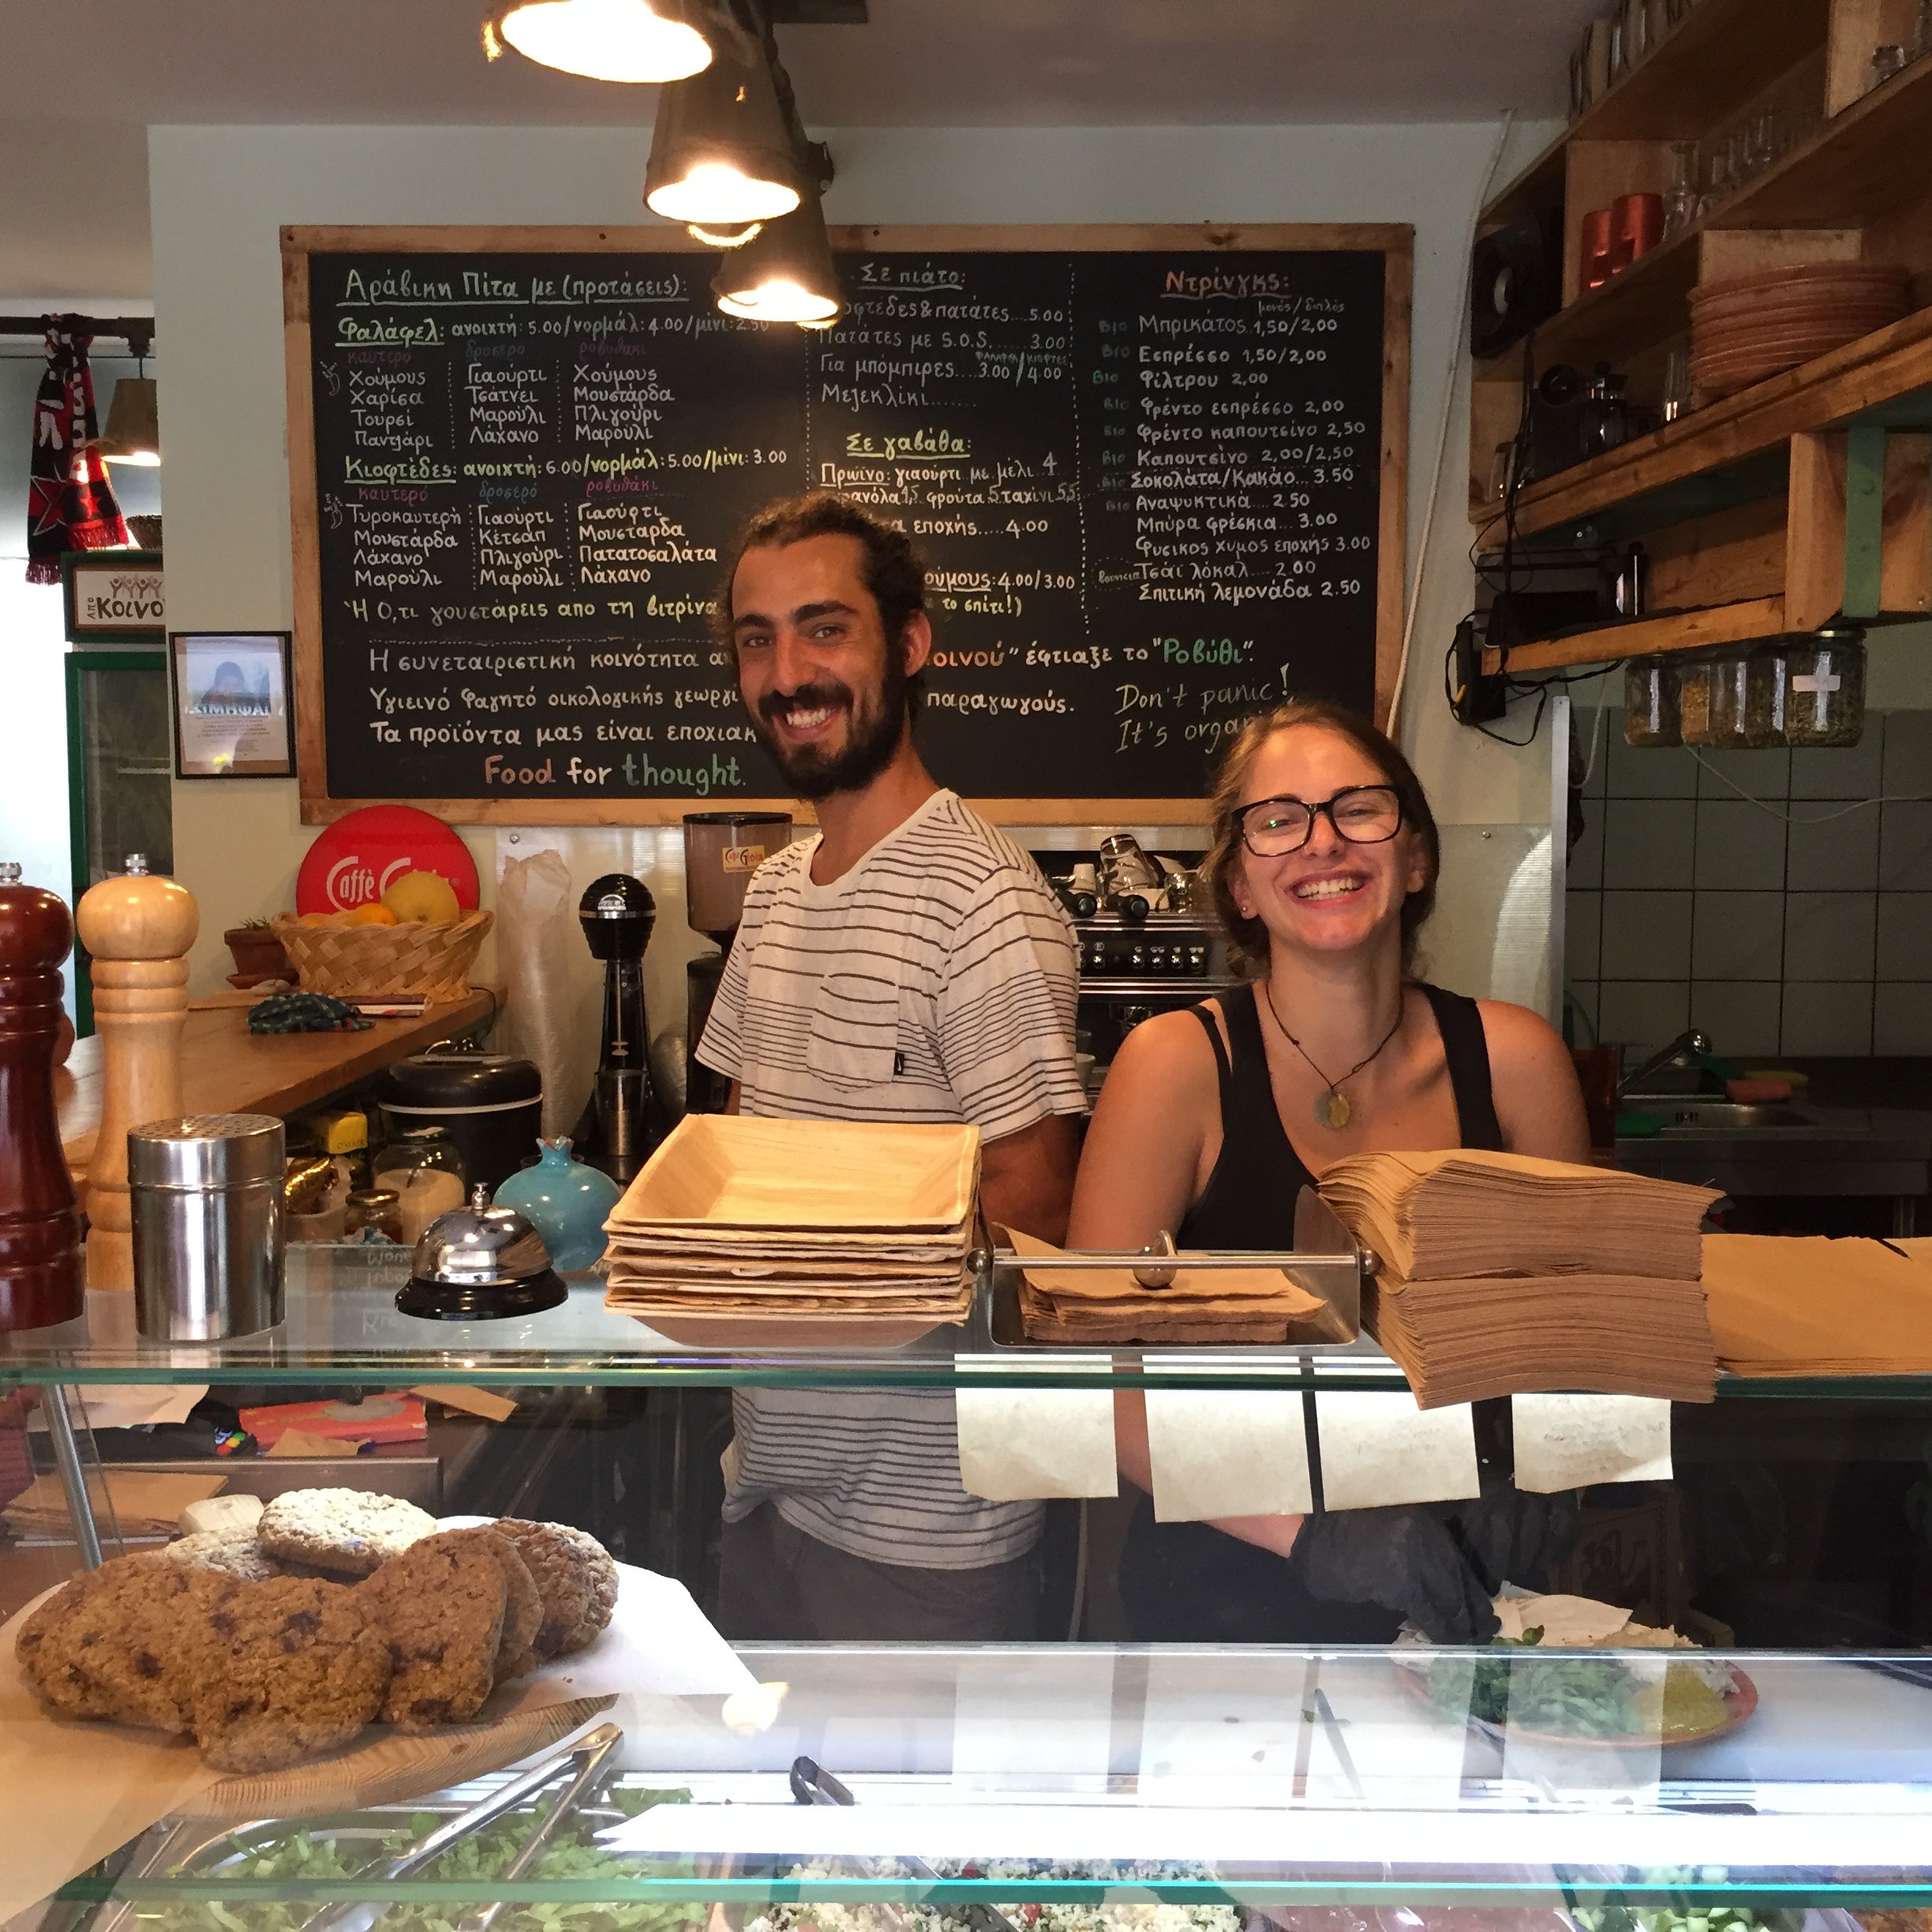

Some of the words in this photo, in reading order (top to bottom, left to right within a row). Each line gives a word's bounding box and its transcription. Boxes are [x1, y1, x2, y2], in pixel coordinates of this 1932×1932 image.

[900, 261, 966, 284] πιάτο:
[462, 271, 519, 298] Πίτα
[531, 277, 556, 305] με
[1028, 309, 1063, 322] 5.00
[338, 316, 444, 347] Φαλάφελ:
[451, 313, 522, 338] ανοιχτή:
[910, 332, 932, 354] με
[1029, 333, 1065, 349] 3.00
[820, 354, 844, 372] Για
[349, 367, 426, 390] Χούμους
[468, 363, 548, 390] Γιαούρτι
[573, 362, 657, 391] Χούμους
[1231, 372, 1269, 386] 2,00
[350, 387, 425, 412] Χαρίσα
[574, 384, 676, 409] Μουστάρδα
[1140, 397, 1203, 420] Φρέντο
[1305, 400, 1345, 415] 2,00
[350, 409, 414, 434] Τουρσί
[470, 406, 547, 429] Μαρούλι
[575, 404, 663, 426] Πλιγούρι
[470, 424, 539, 444] Λάχανο
[575, 423, 653, 448] Μαρούλι
[846, 433, 874, 452] Σε
[885, 427, 972, 461] γαβάθα:
[1136, 424, 1203, 446] Φρέντο
[1211, 420, 1317, 439] καπουτσίνο
[1327, 421, 1365, 439] 2,50
[344, 455, 457, 485] Κιοφτέδες:
[463, 455, 542, 478] ανοιχτή:
[754, 448, 787, 465] 3.00
[1137, 444, 1249, 466] Καπουτσίνο
[895, 464, 960, 489] γιαούρτι
[971, 466, 989, 485] με
[1313, 467, 1354, 485] 3.50
[1136, 489, 1251, 511] Αναψυκτικά
[1272, 493, 1310, 508] 2.50
[345, 504, 462, 531] Τυροκαυτερή
[477, 504, 554, 531] Γιαούρτι
[578, 502, 663, 525] Γιαούρτι
[914, 513, 978, 536] εποχής
[1005, 519, 1048, 539] 4.00
[1137, 515, 1200, 537] Μπύρα
[1298, 512, 1338, 529] 3.00
[354, 529, 459, 557] Μουστάρδα
[579, 541, 717, 564] Πατατοσαλάτα
[1336, 536, 1370, 551] 3.00
[353, 549, 423, 566] Λάχανο
[480, 545, 564, 571] Πλιγούρι
[355, 568, 442, 592] Μαρούλι
[480, 567, 564, 593] Μαρούλι
[581, 564, 651, 584] Λάχανο
[924, 566, 995, 593] ούμους:
[1189, 560, 1249, 581] λόκαλ
[1275, 560, 1316, 576] 2.00
[1138, 582, 1206, 604] Σπιτική
[1210, 578, 1312, 607] λεμονάδα
[1320, 580, 1361, 597] 2.50
[430, 598, 549, 627] γουστάρεις
[607, 601, 635, 619] τη
[369, 648, 389, 672] Η
[398, 645, 575, 676] συνεταιριστική
[590, 642, 699, 668] κοινότητα
[1122, 647, 1148, 661] το
[369, 687, 451, 714] Υγιεινό
[548, 684, 664, 708] οικολογικής
[1114, 683, 1187, 715] Don't
[369, 721, 401, 743] Τα
[537, 724, 582, 747] μας
[597, 719, 654, 741] είναι
[484, 754, 556, 784] Food
[567, 757, 612, 785] for
[622, 753, 747, 796] thought.
